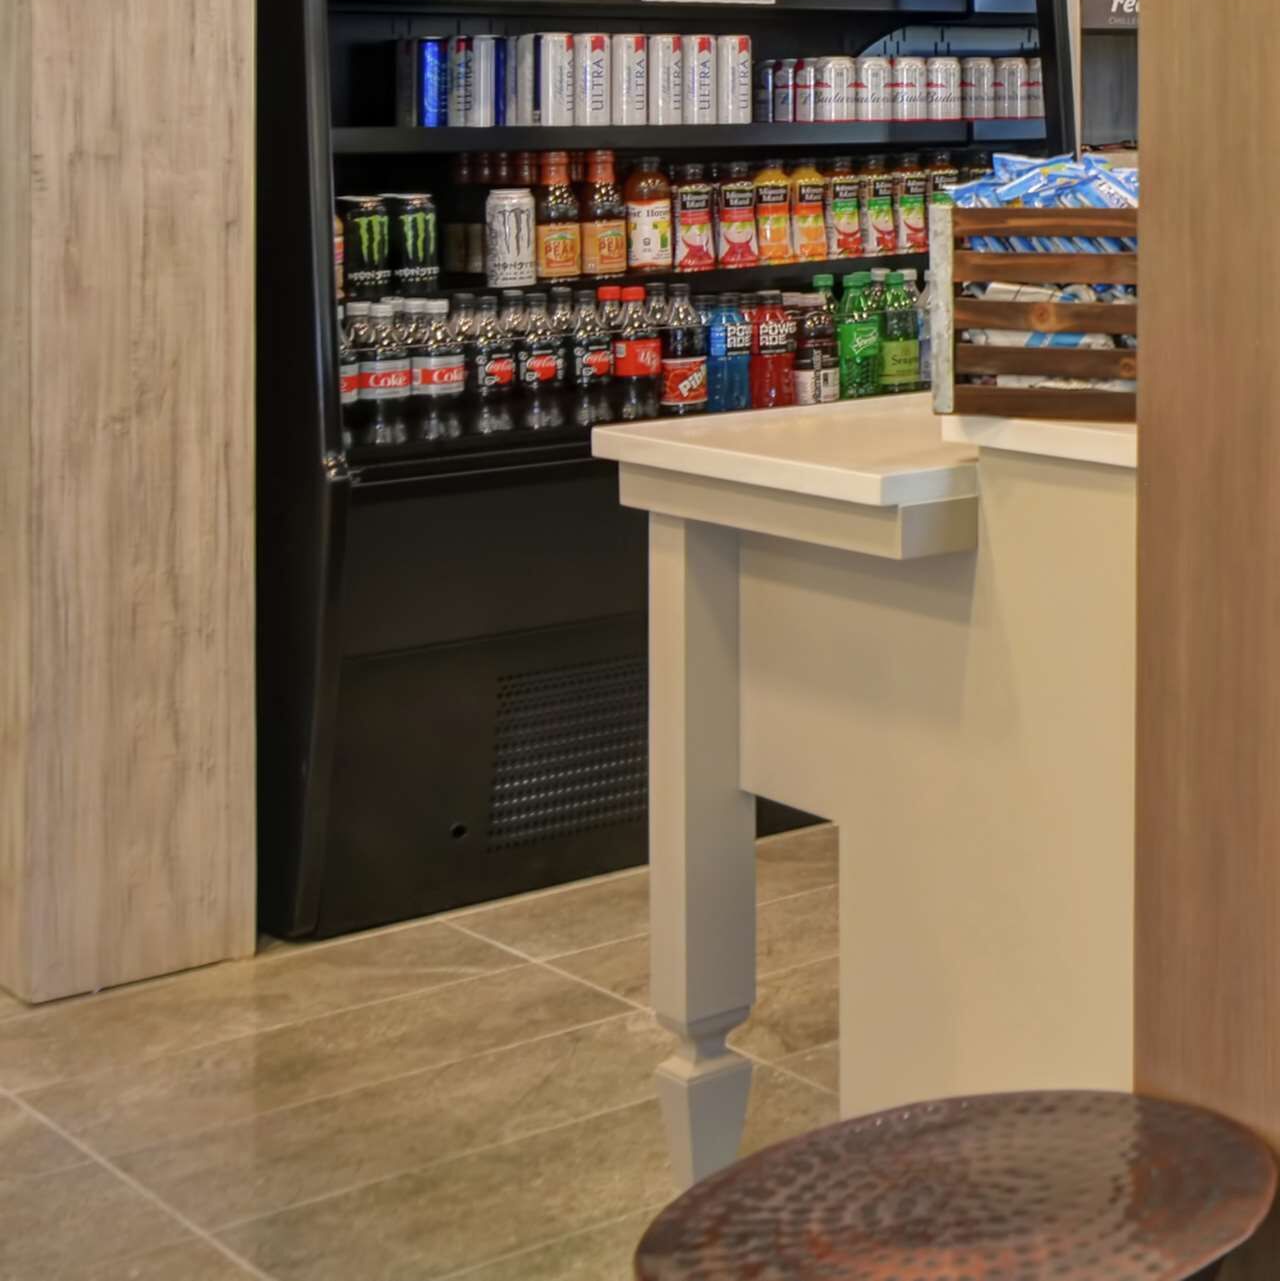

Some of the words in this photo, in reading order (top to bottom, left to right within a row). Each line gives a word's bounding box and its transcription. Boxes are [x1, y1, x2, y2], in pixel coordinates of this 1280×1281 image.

[591, 58, 604, 111] ULTRA
[699, 59, 711, 111] ULTRA
[369, 373, 409, 387] Coke
